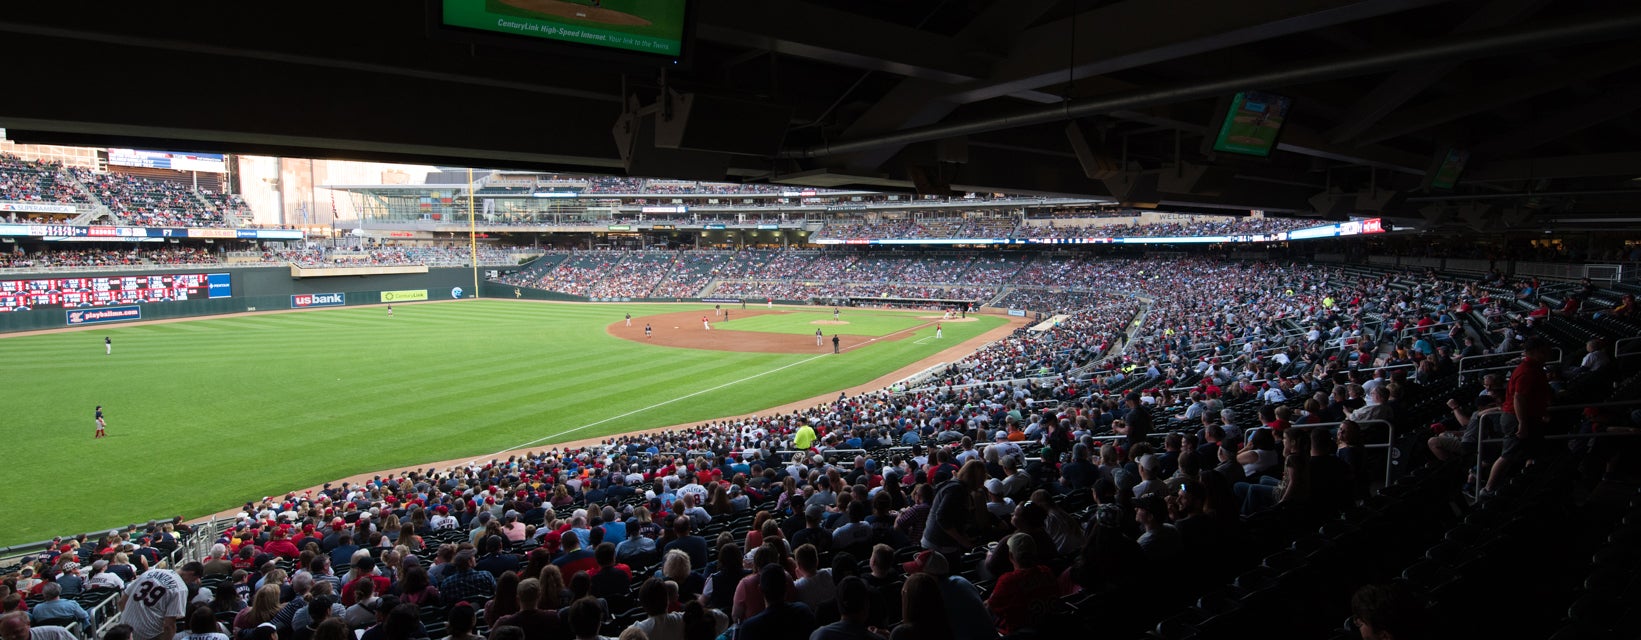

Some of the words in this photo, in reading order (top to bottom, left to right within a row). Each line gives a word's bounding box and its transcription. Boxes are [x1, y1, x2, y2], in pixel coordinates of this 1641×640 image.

[497, 18, 540, 32] CenturyLink
[540, 25, 580, 38] High-Speed
[609, 35, 623, 44] Your
[17, 204, 69, 212] SUPERAMERICA
[85, 310, 138, 320] playballmn.com
[146, 570, 177, 591] SANTANA
[133, 580, 166, 607] 39
